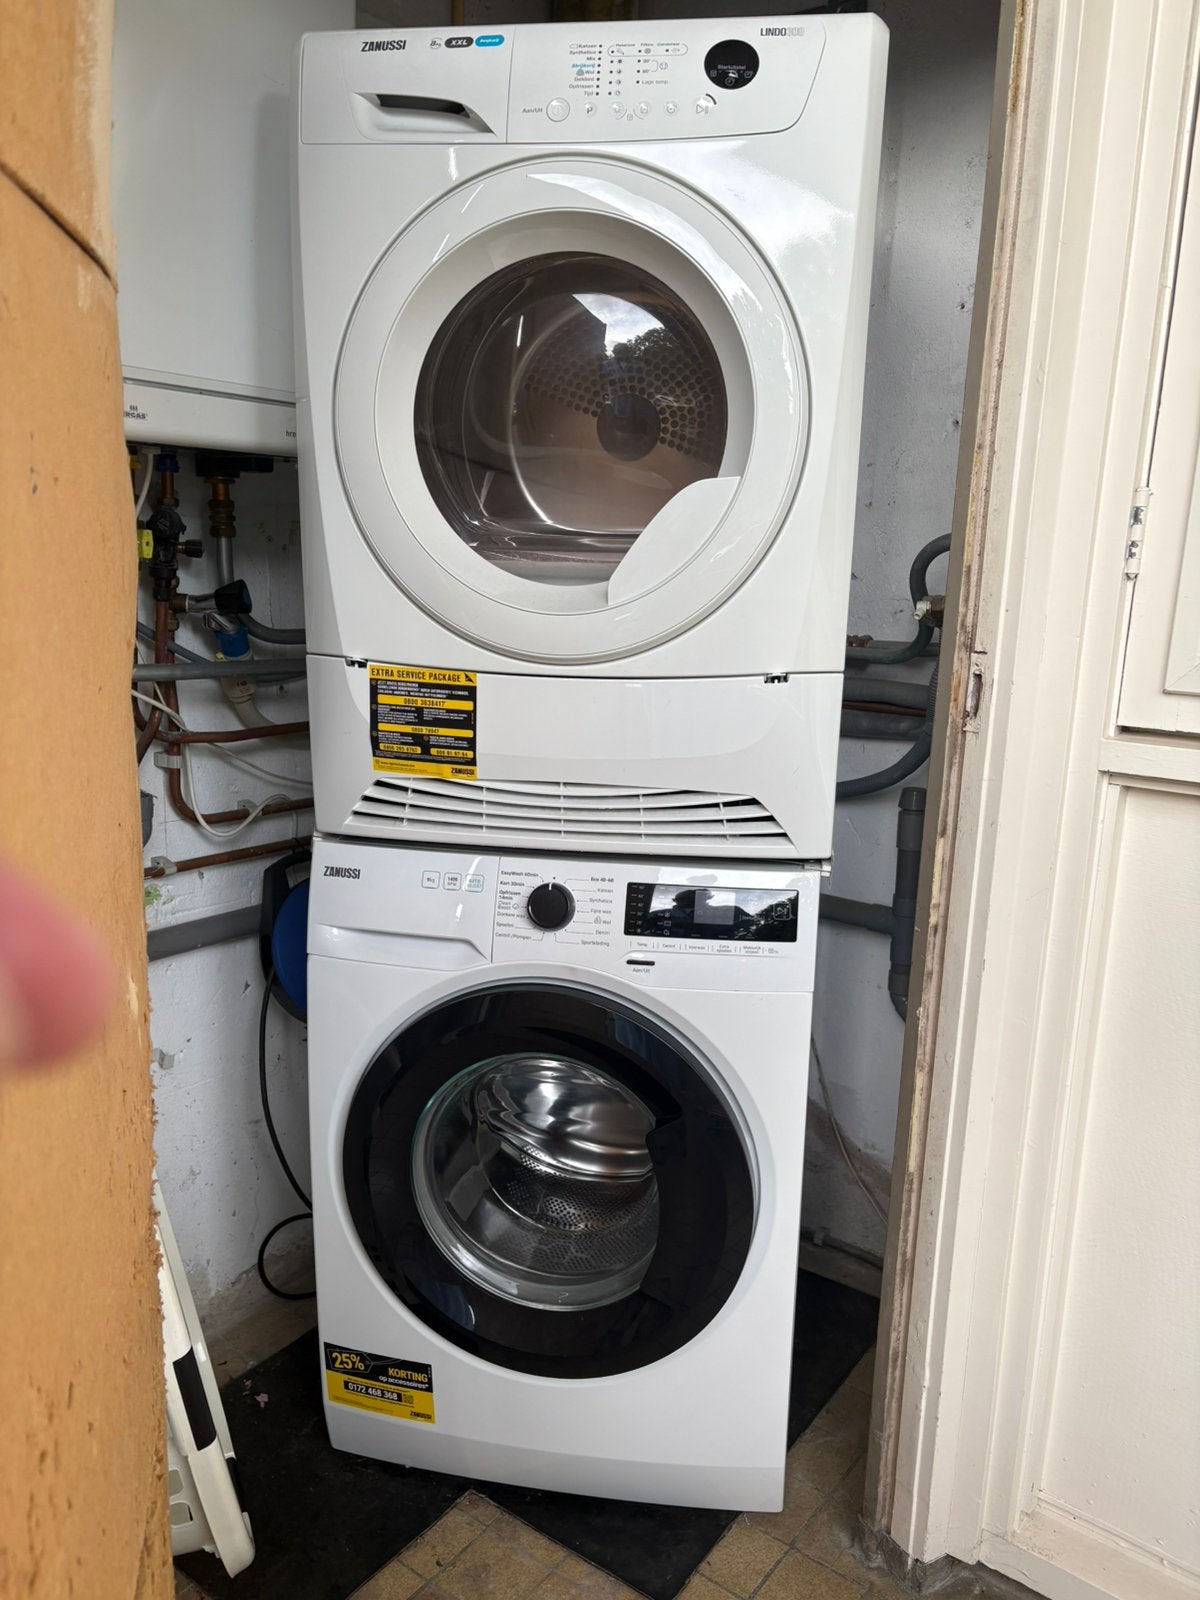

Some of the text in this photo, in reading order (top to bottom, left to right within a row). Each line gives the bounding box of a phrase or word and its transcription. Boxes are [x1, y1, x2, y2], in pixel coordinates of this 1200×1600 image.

[361, 39, 407, 53] ZANUSSI
[450, 38, 468, 46] XXL
[371, 667, 461, 683] EXTRA SERVICE PACKAGE
[450, 766, 475, 776] ZANUSSI
[323, 865, 362, 880] ZANUSSI
[501, 870, 524, 878] EasyWash
[332, 1352, 365, 1371] 25%
[378, 1375, 388, 1383] op
[387, 1367, 428, 1383] KORTING
[348, 1382, 366, 1393] 0172
